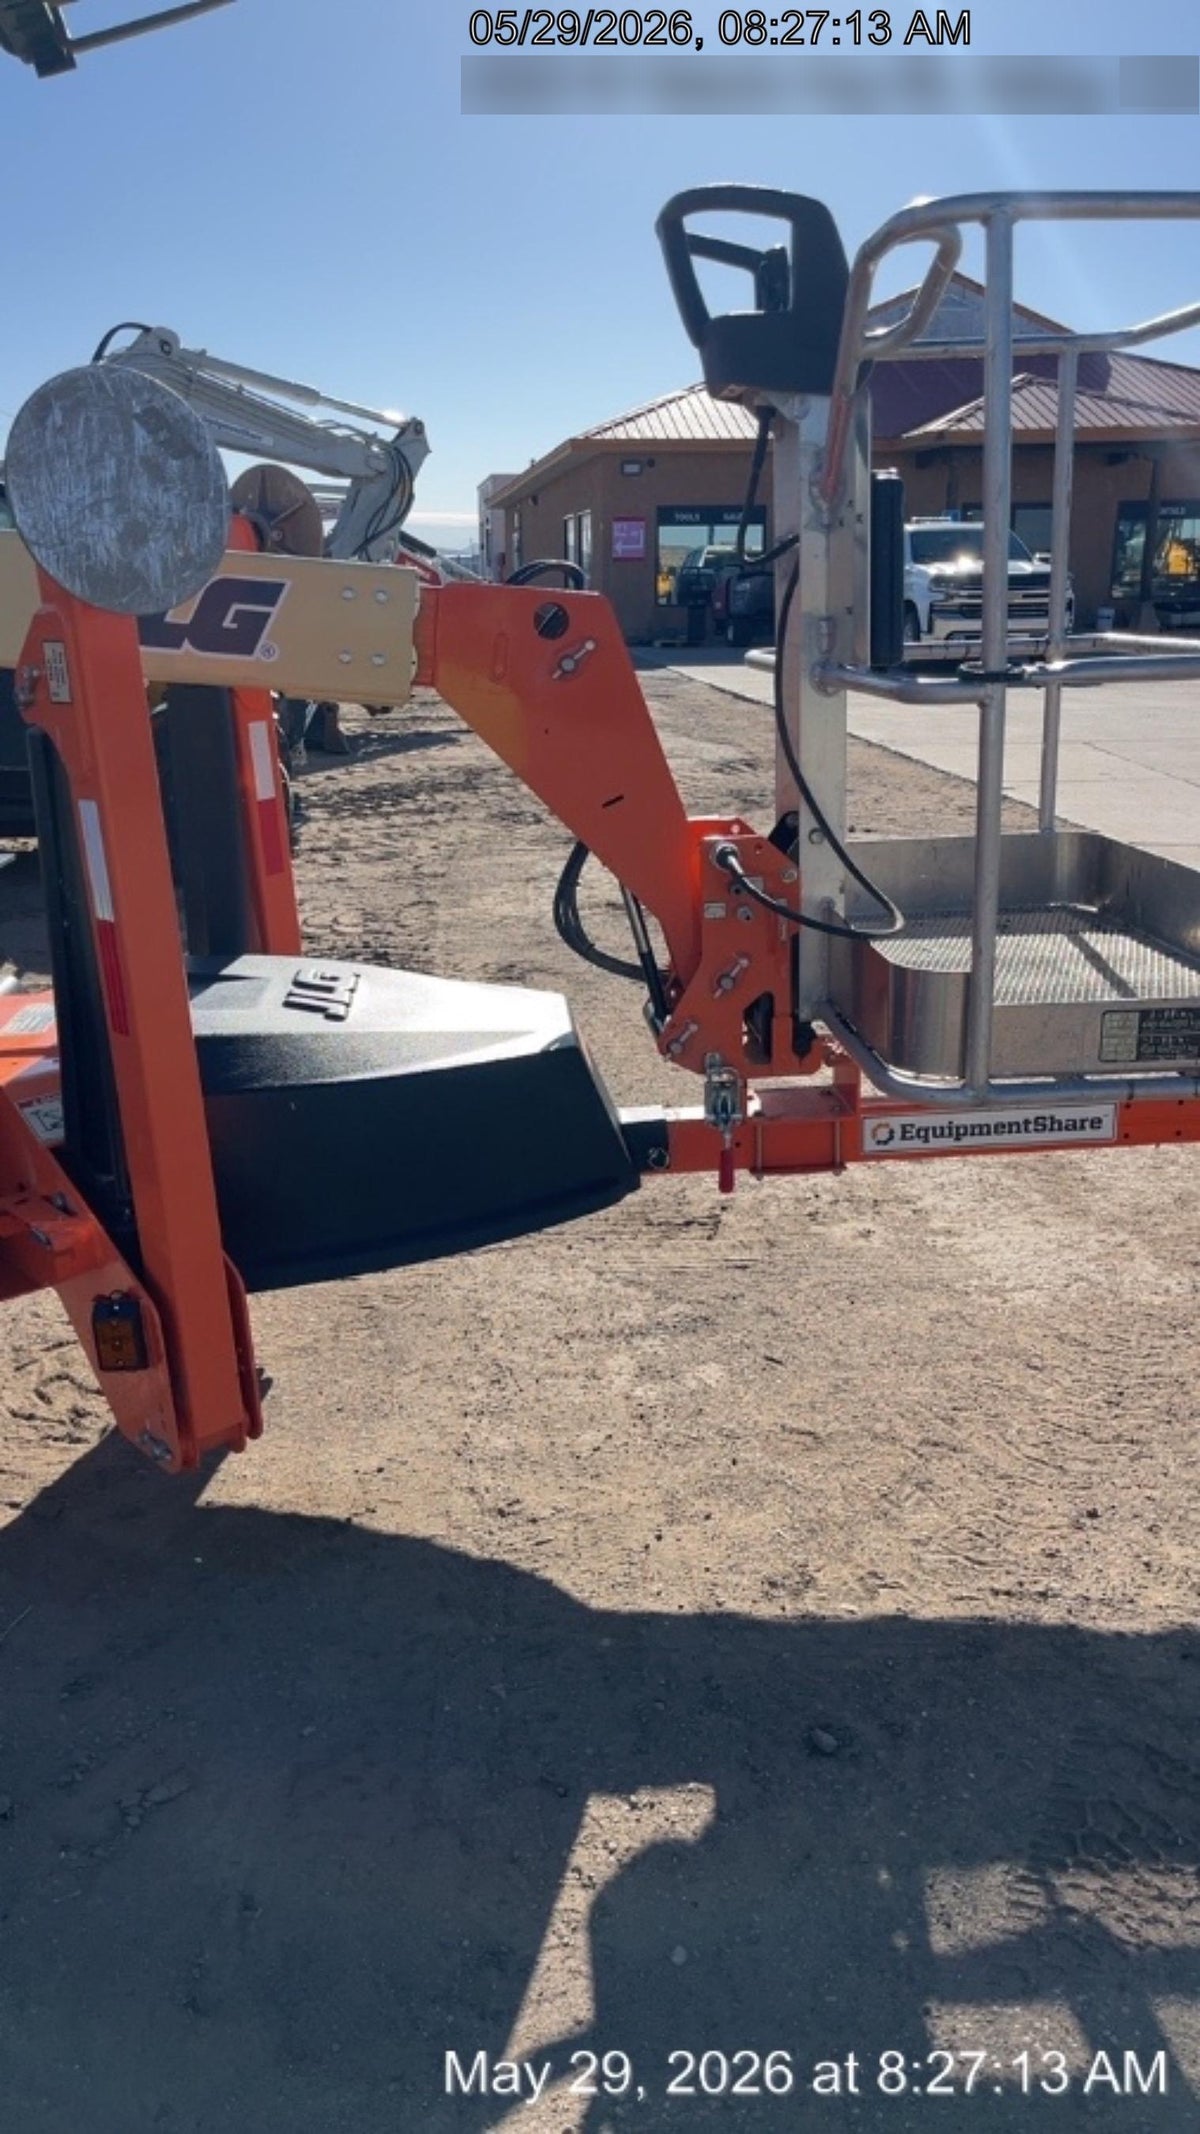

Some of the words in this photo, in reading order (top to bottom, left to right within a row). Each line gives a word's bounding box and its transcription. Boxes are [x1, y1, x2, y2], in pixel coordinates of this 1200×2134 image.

[137, 574, 292, 661] LG
[282, 968, 362, 1021] JLG
[899, 1114, 1104, 1143] EquipmentShare
